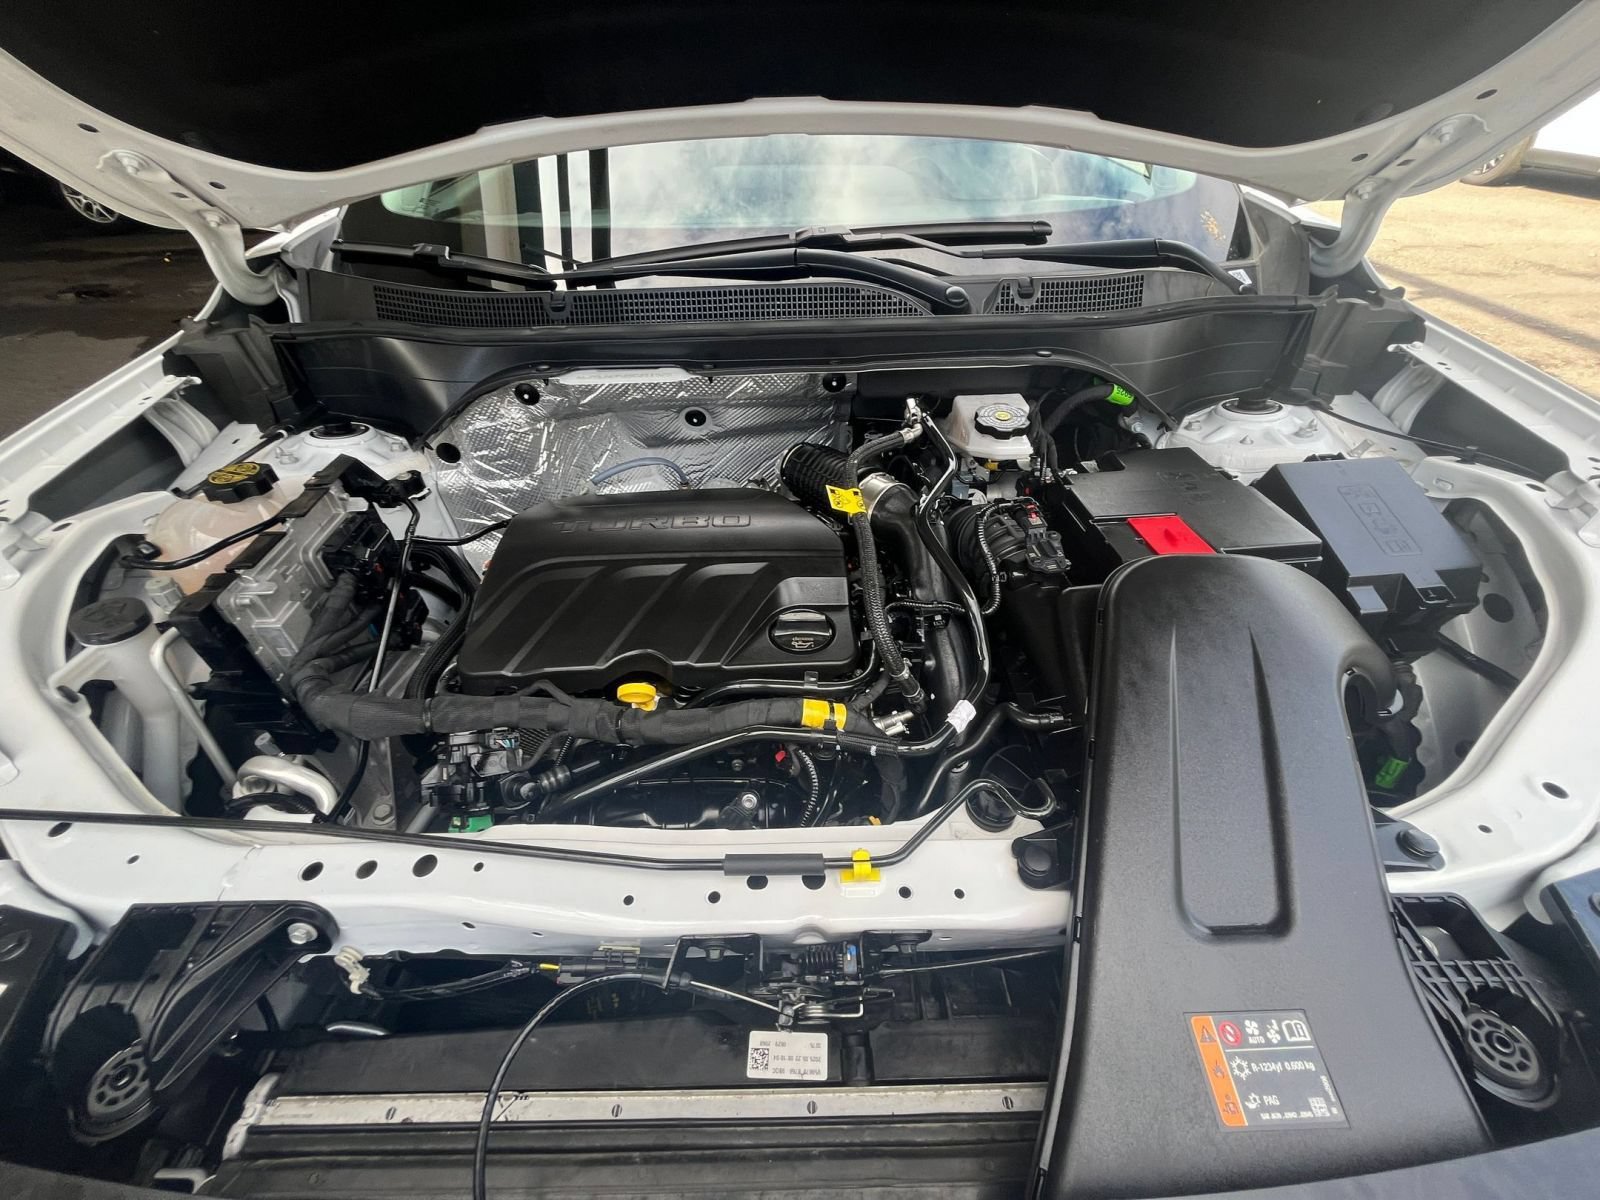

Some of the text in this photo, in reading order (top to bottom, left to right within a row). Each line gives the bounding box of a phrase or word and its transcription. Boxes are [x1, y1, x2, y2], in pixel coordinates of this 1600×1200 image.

[552, 514, 751, 533] TURBO
[1248, 1036, 1265, 1044] AUTO
[1251, 1062, 1283, 1073] R-1234yf
[1303, 1060, 1316, 1071] kg
[1263, 1095, 1281, 1106] PAG
